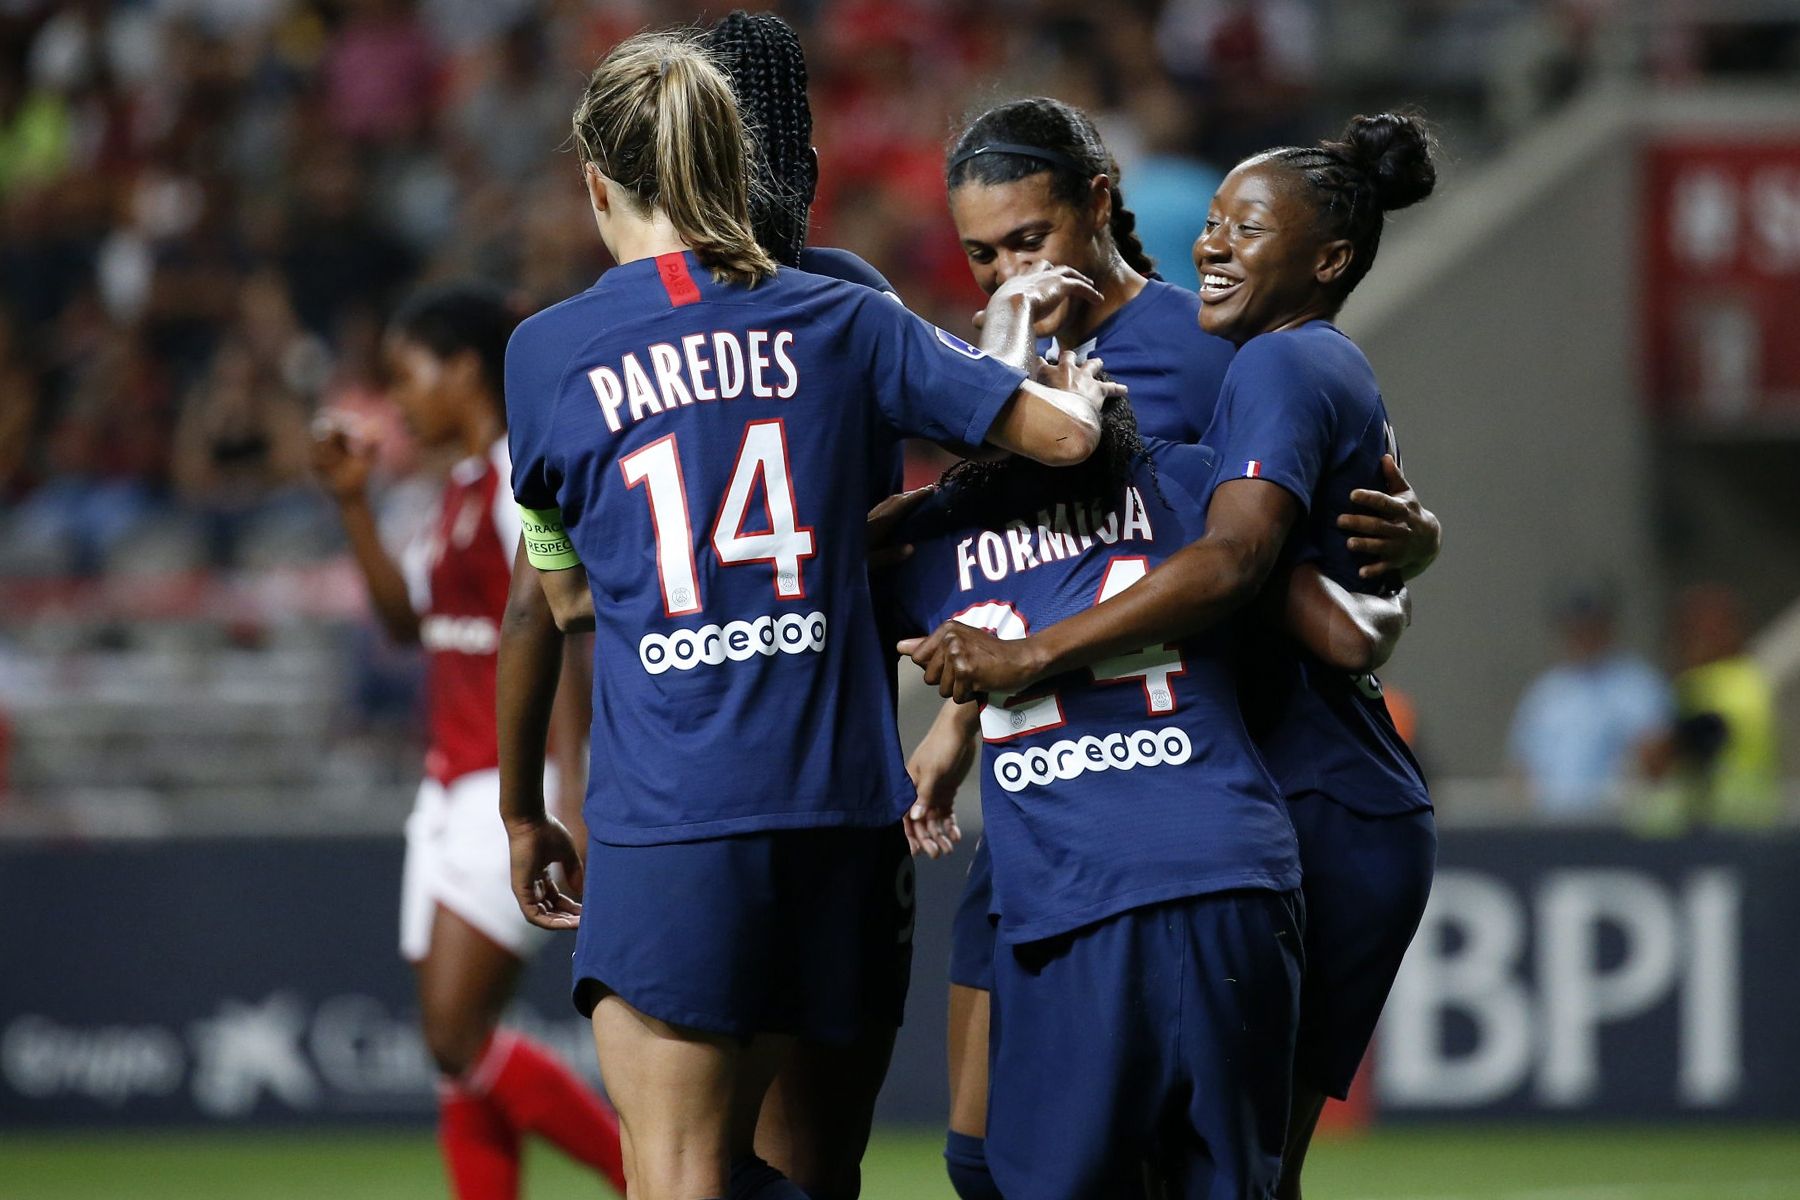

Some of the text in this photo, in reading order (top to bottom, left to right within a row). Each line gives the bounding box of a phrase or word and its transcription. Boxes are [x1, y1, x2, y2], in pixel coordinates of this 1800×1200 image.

[589, 331, 798, 434] PAREDES
[528, 540, 573, 553] RESPEC
[535, 521, 562, 533] RAC
[619, 418, 816, 617] 14
[641, 612, 826, 671] ooredoo
[996, 729, 1190, 789] ooredoo
[1376, 870, 1742, 1105] BPI
